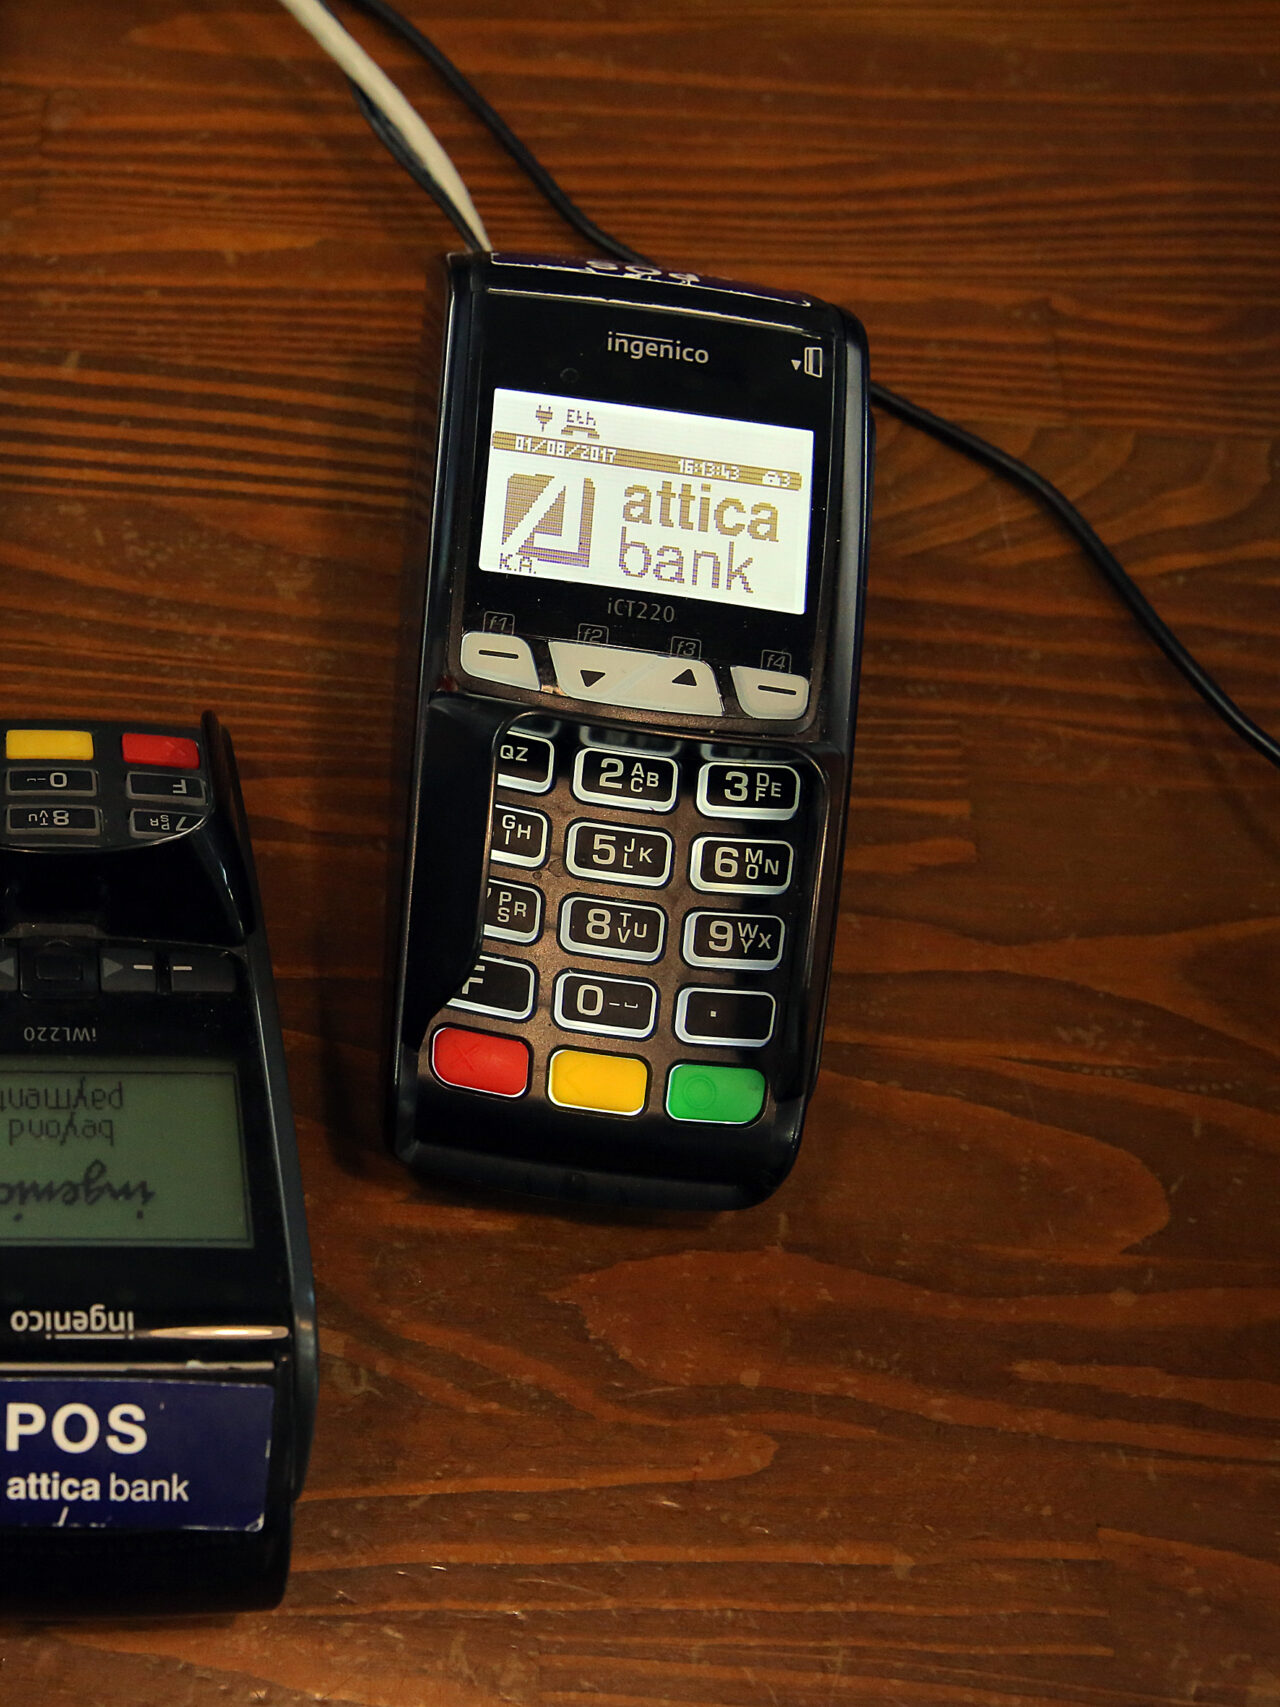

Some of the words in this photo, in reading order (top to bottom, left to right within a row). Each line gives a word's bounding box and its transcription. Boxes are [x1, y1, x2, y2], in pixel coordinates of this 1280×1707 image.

[606, 331, 710, 365] ingenico
[566, 408, 598, 428] Eth
[514, 434, 619, 465] 01/08/2017
[676, 458, 742, 483] 16:13:43
[622, 480, 780, 544] attica
[618, 525, 755, 594] bank
[607, 598, 676, 624] iCT220
[171, 778, 188, 795] F
[599, 757, 624, 790] 2
[724, 771, 749, 802] 3
[51, 809, 70, 827] 8
[591, 834, 618, 866] 5
[714, 846, 739, 878] 6
[586, 908, 611, 941] 8
[708, 920, 733, 953] 9
[23, 1026, 98, 1043] iWL220
[8, 1112, 115, 1147] beyond
[10, 1303, 136, 1341] ingenico
[5, 1401, 148, 1455] POS
[6, 1471, 101, 1503] attica
[109, 1472, 190, 1503] bank
